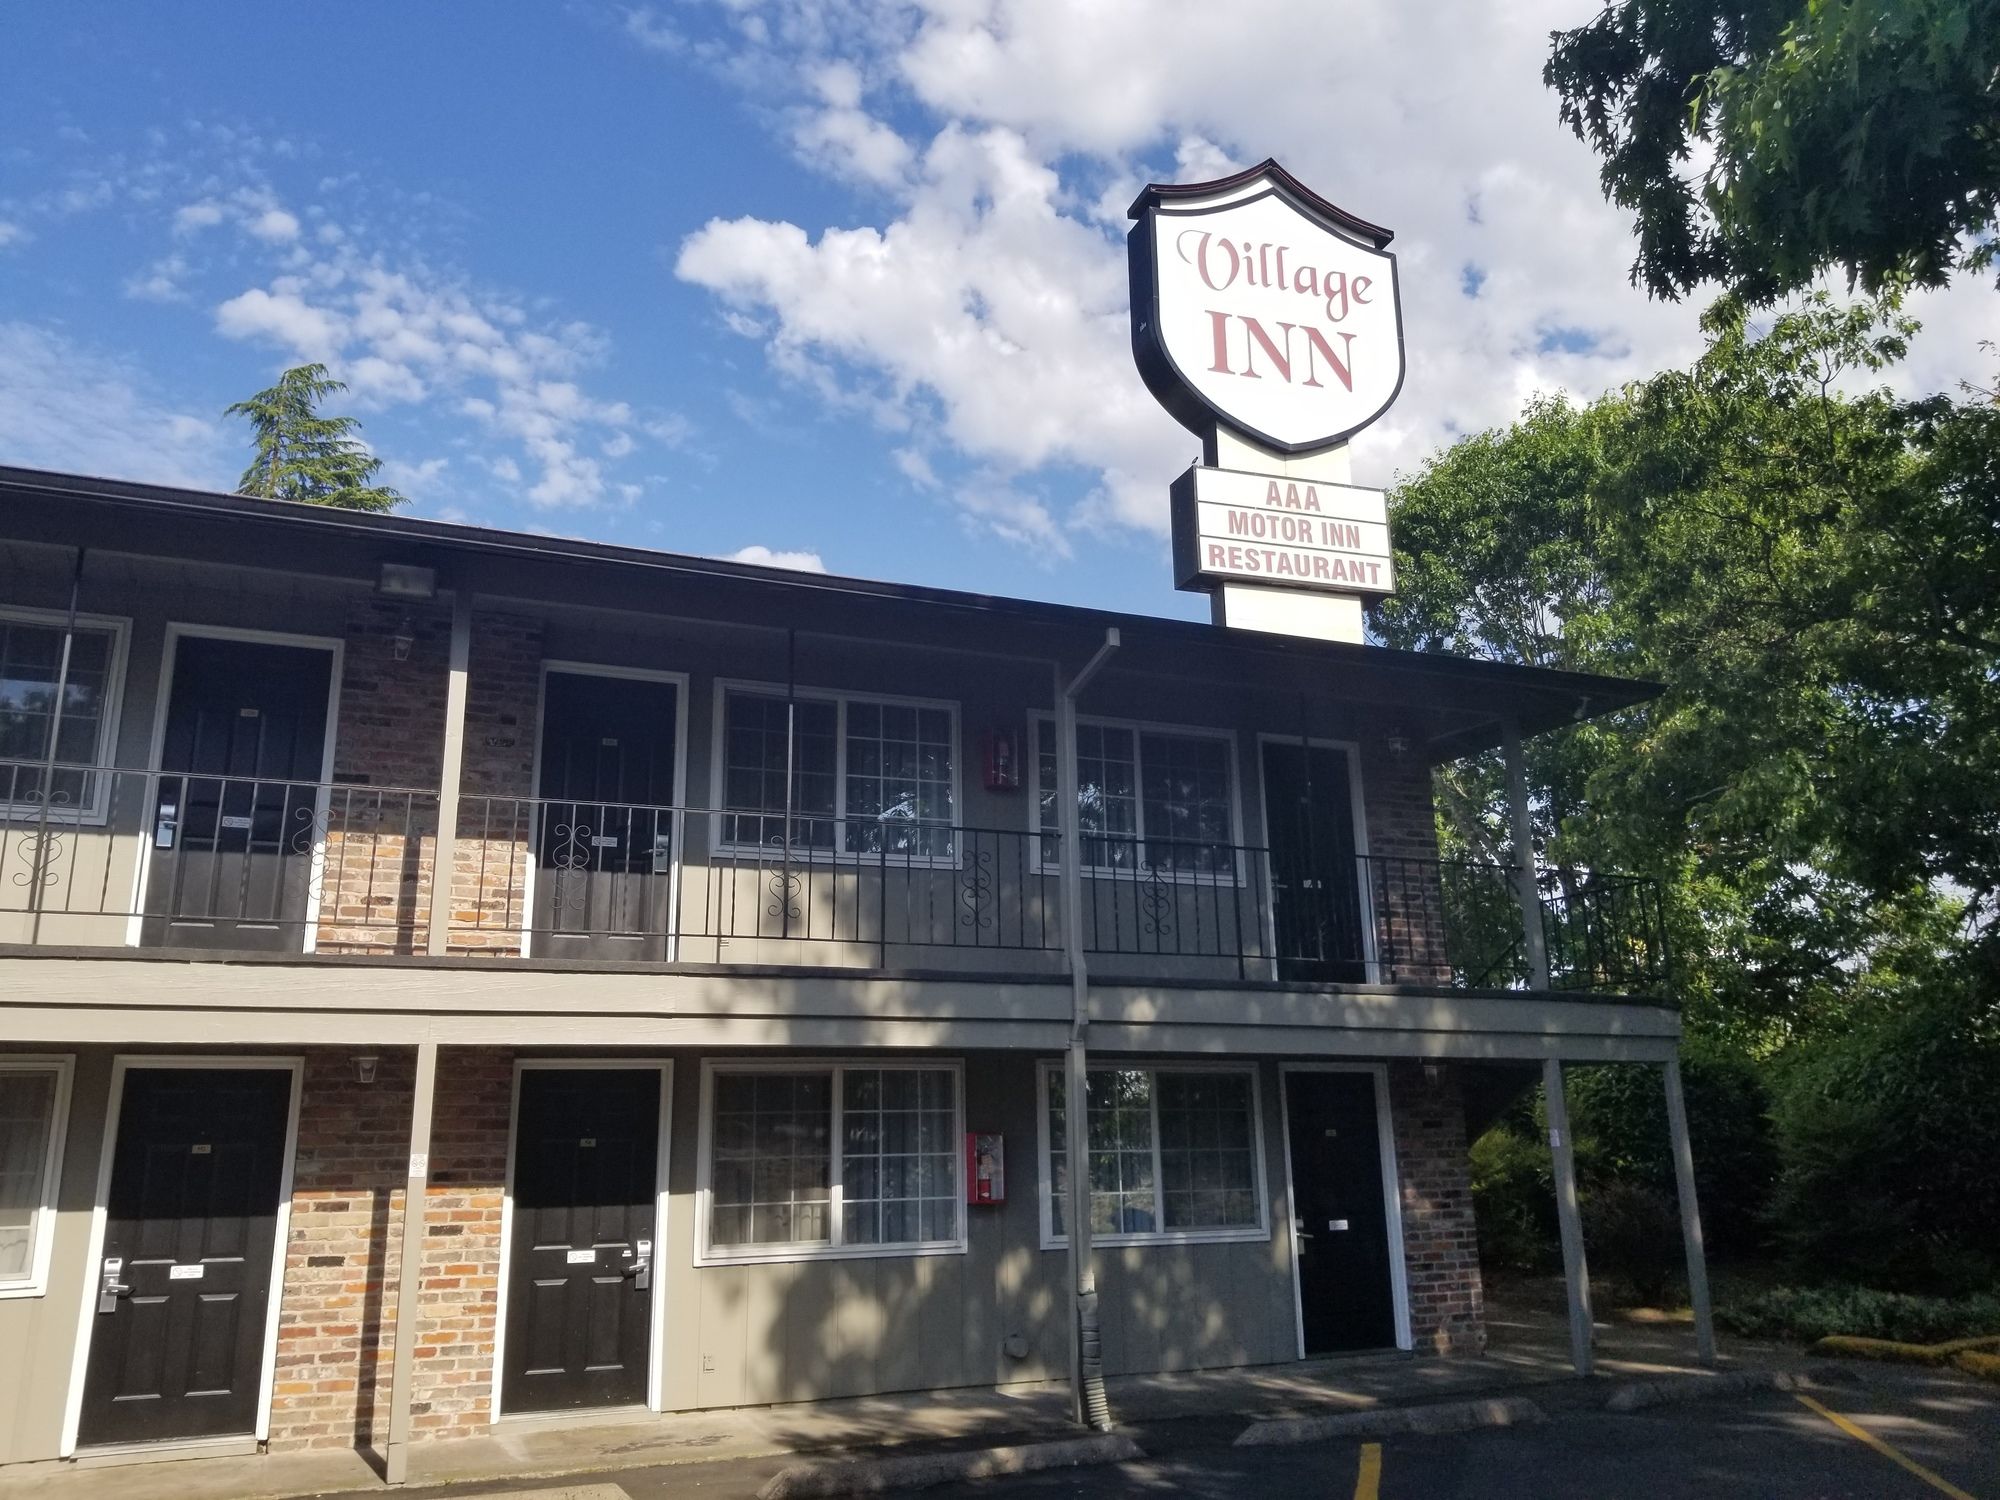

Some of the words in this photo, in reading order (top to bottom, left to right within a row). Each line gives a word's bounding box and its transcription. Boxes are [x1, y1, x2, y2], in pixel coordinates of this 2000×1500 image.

[1176, 229, 1373, 323] Village
[1204, 309, 1357, 393] INN
[1265, 480, 1321, 513] AAA
[1227, 510, 1313, 543] MOTOR
[1321, 522, 1360, 550] INN
[1208, 543, 1381, 586] RESTAURANT
